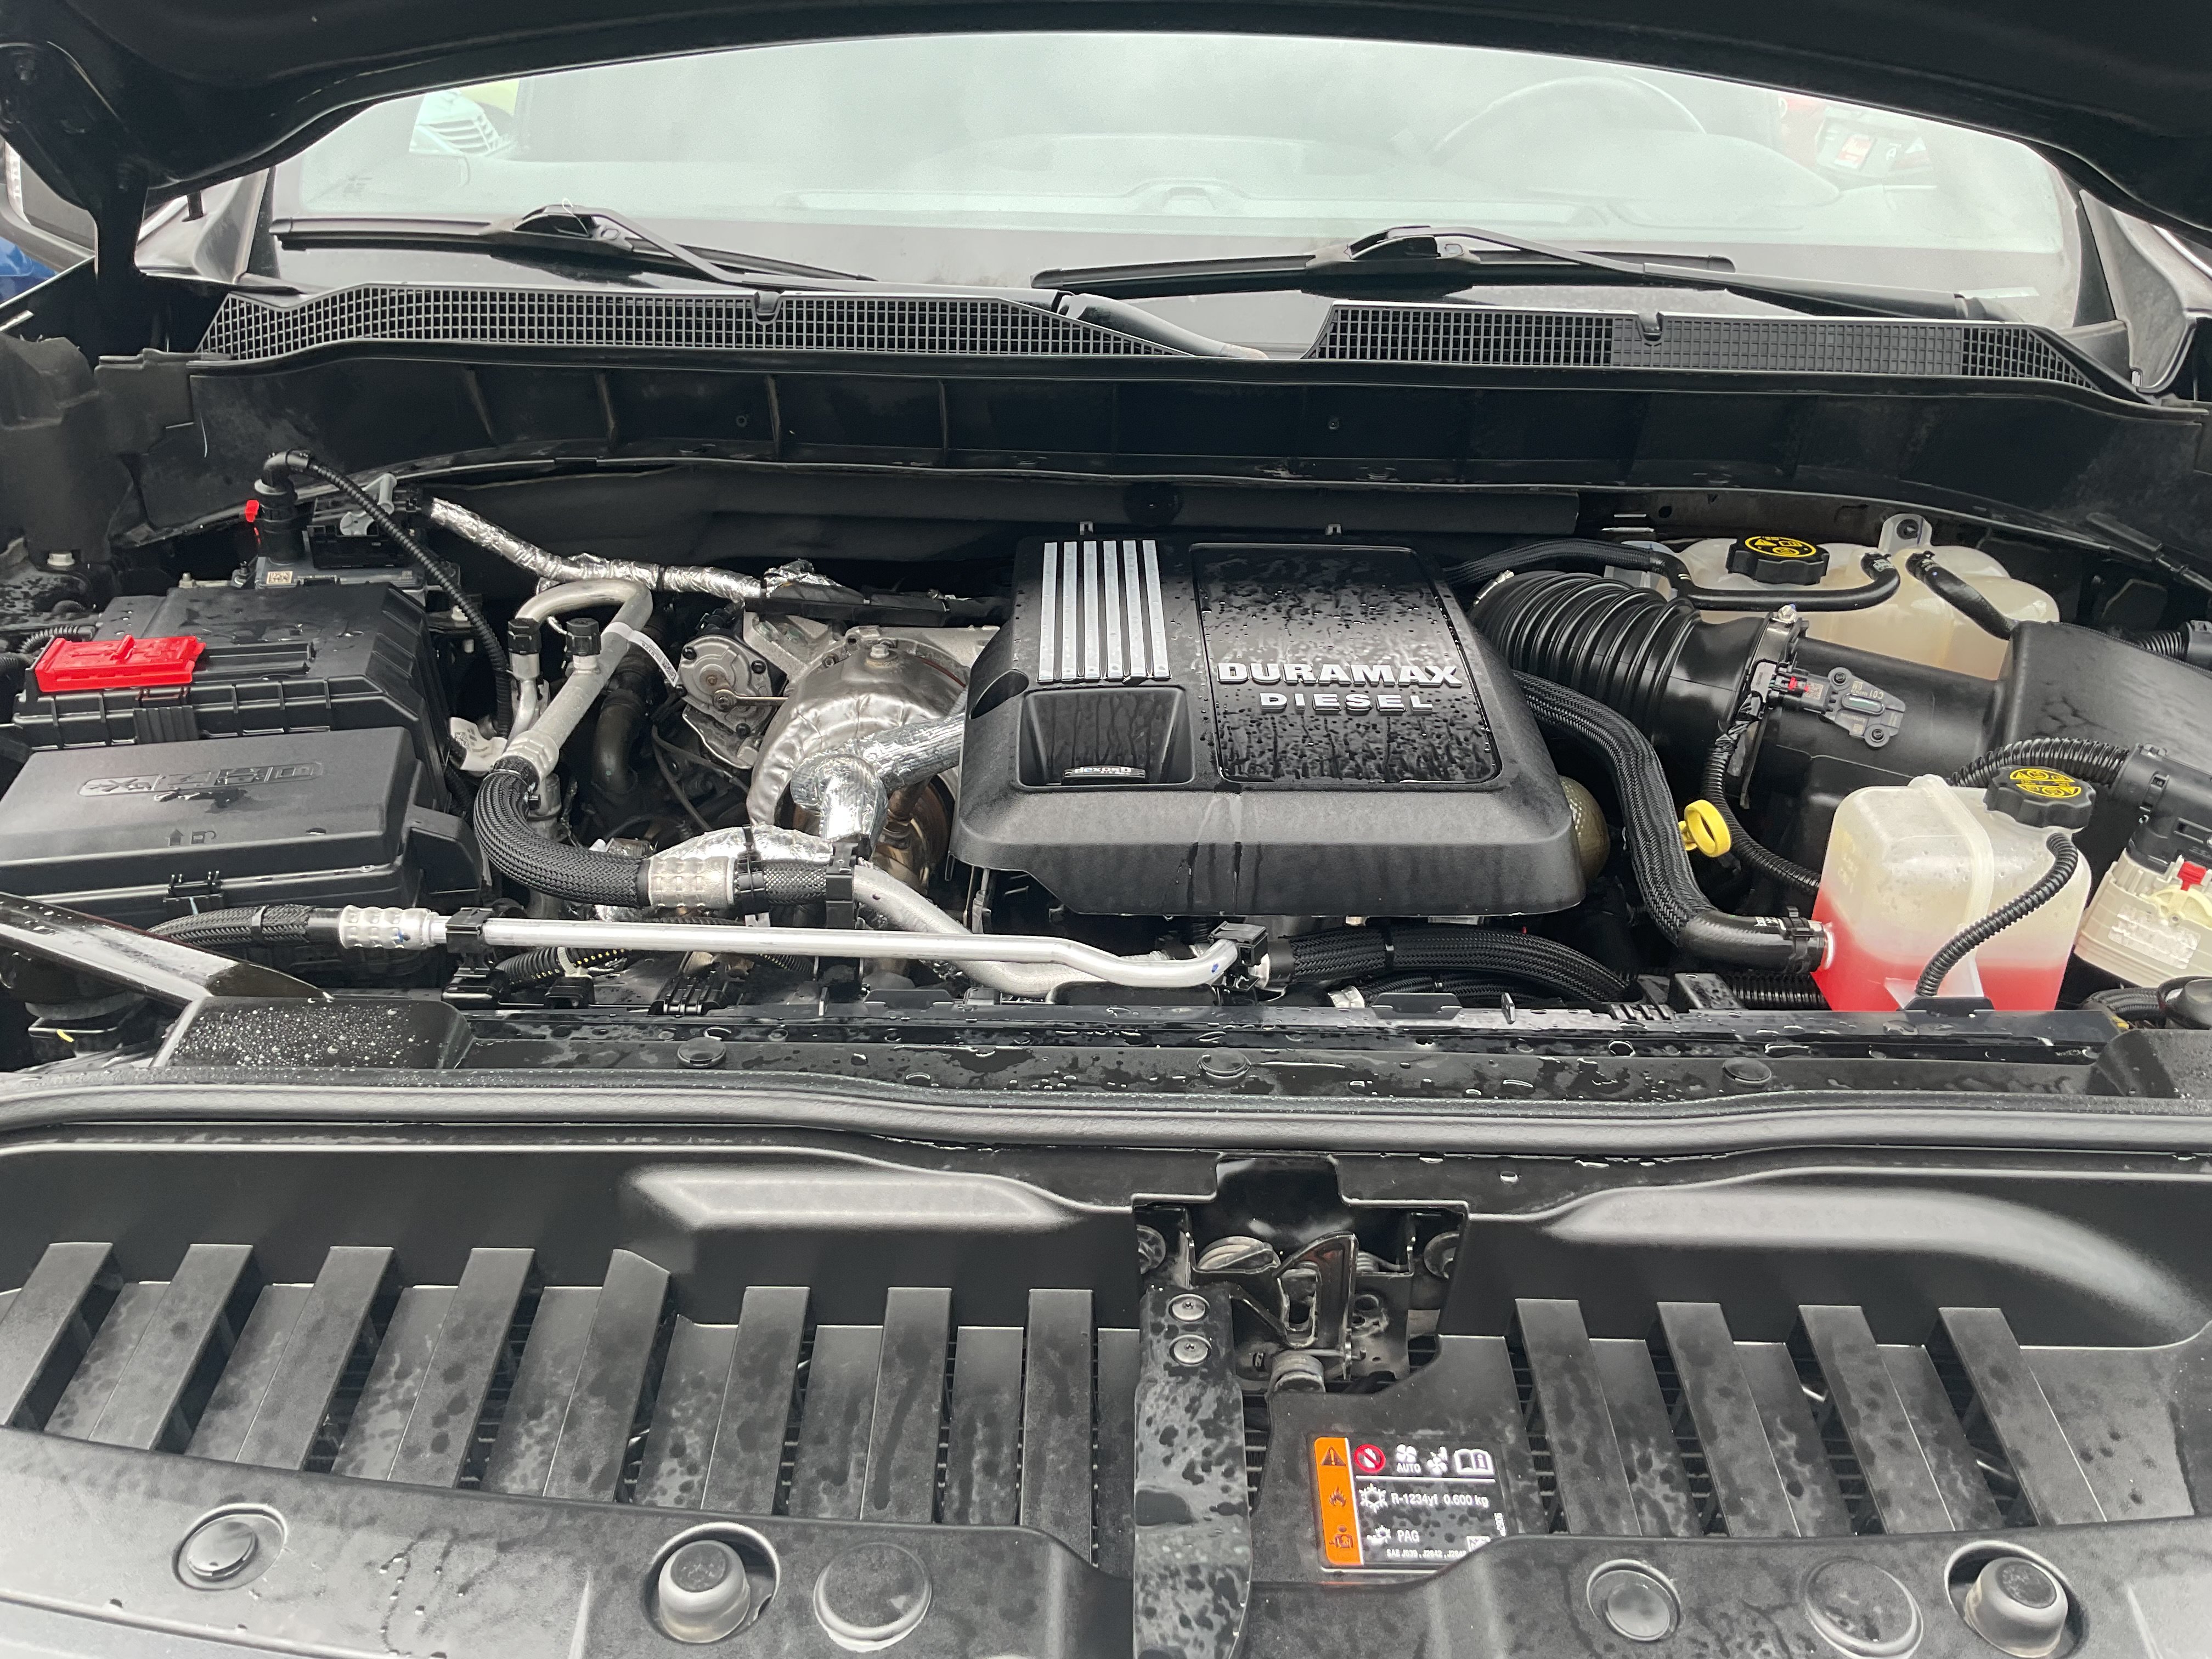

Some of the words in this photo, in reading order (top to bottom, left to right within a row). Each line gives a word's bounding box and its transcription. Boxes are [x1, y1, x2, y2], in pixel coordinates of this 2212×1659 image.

[1217, 663, 1463, 687] DURAMAX
[1260, 692, 1434, 712] DIESEL
[1397, 1463, 1421, 1473] AUTO
[1391, 1492, 1438, 1506] R-1234yf
[1443, 1494, 1471, 1505] 0.600
[1474, 1494, 1489, 1509] kg
[1397, 1530, 1420, 1543] PAG
[1386, 1549, 1400, 1558] SAE
